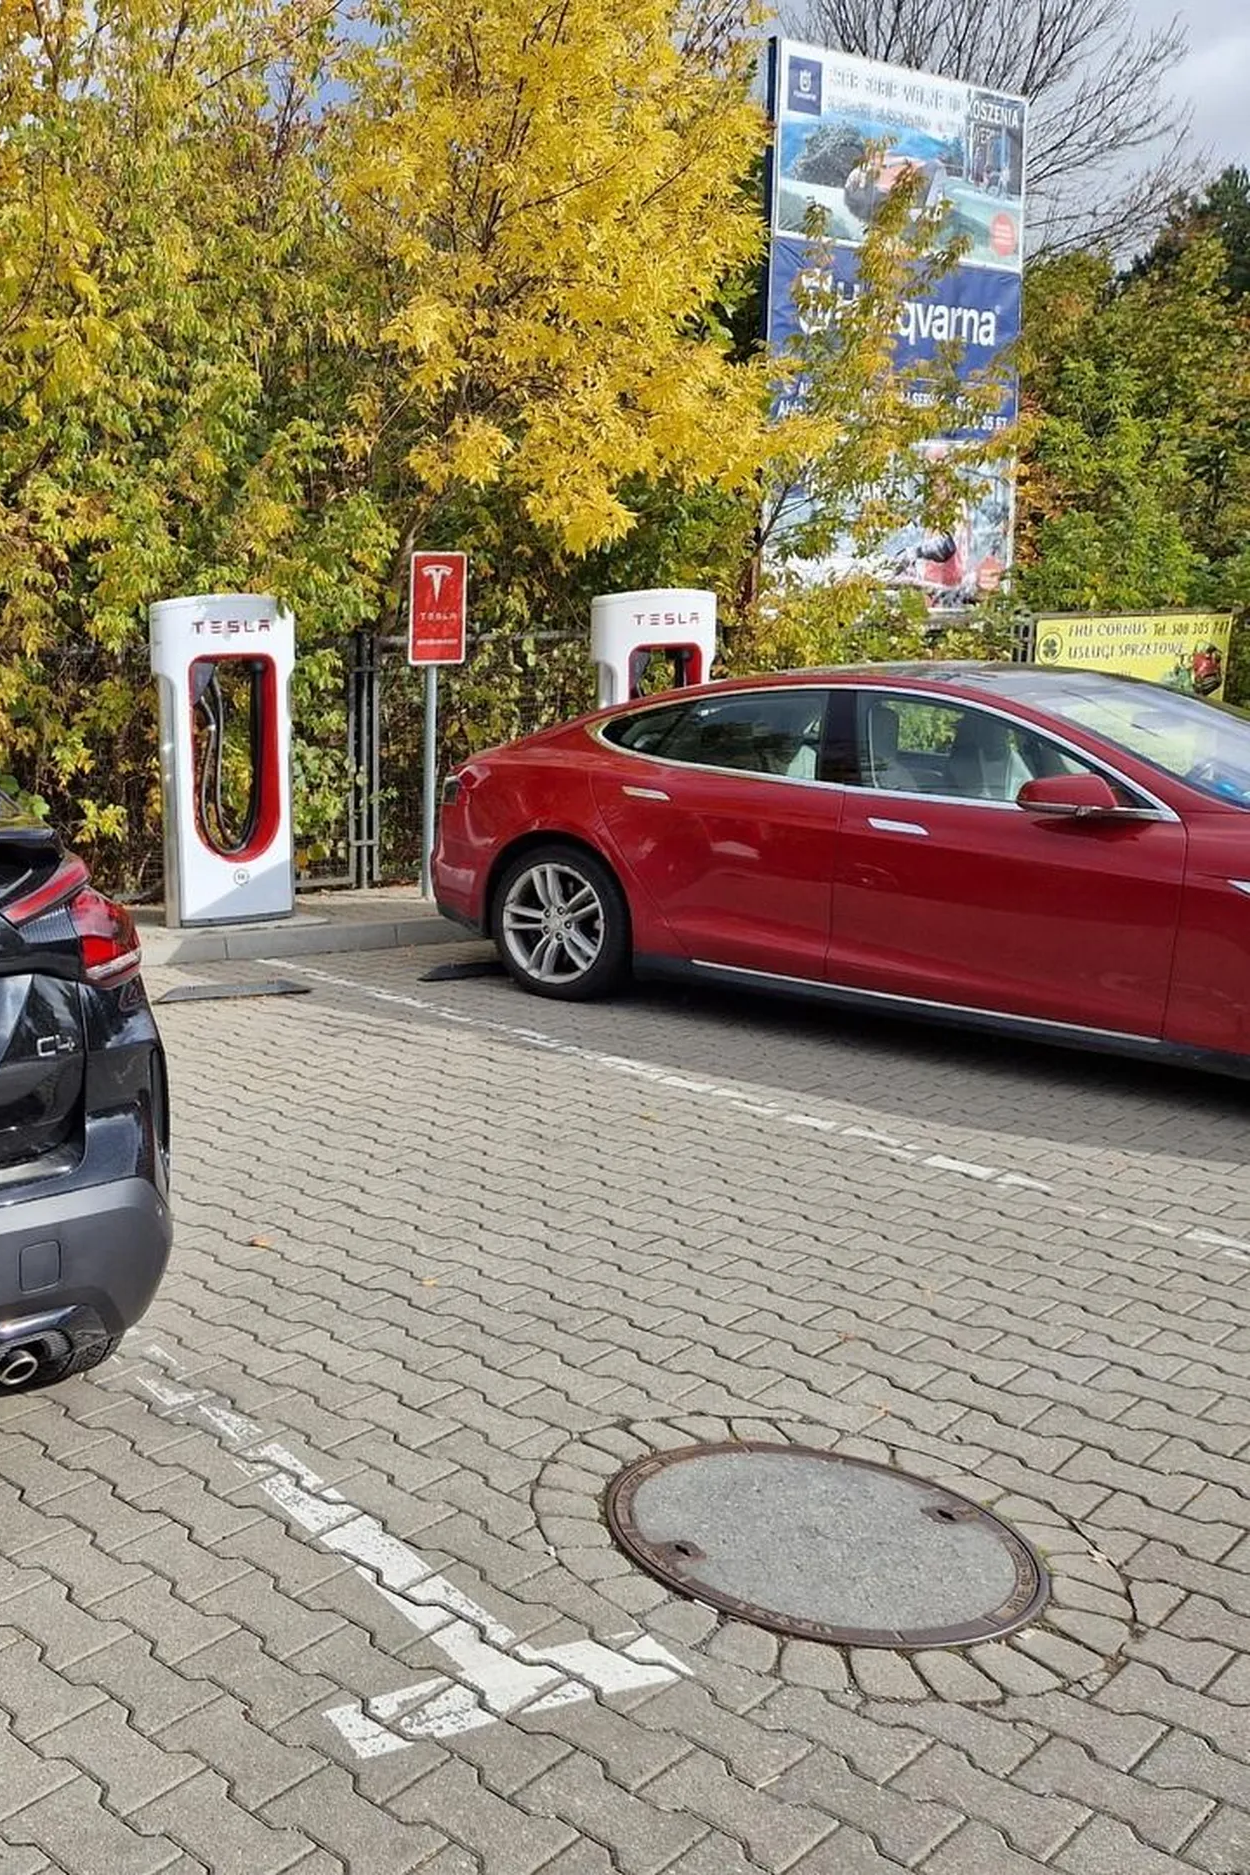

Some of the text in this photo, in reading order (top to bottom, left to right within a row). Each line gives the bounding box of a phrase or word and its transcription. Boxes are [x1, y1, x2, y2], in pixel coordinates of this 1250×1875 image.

[836, 281, 996, 346] Hqvarna
[419, 611, 458, 621] TESLA
[633, 612, 700, 626] TESLA
[192, 619, 271, 635] TESLA
[1096, 622, 1148, 637] CORNUS
